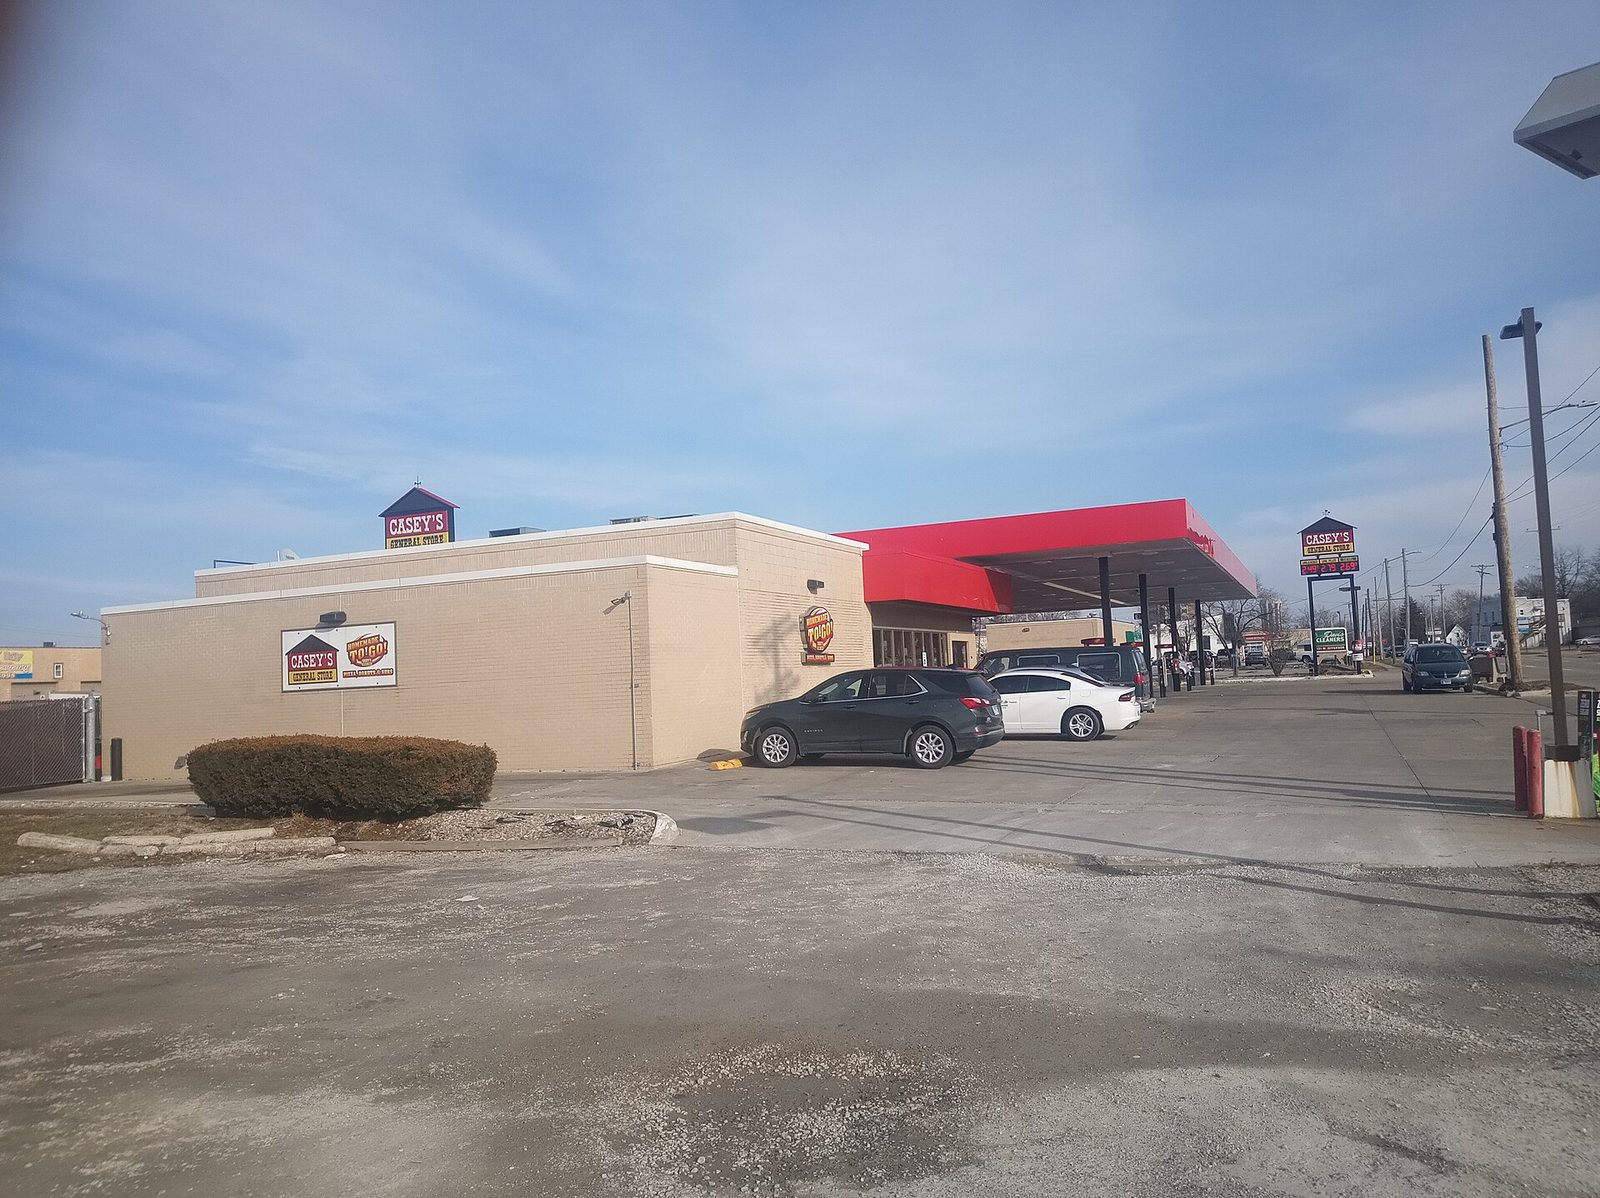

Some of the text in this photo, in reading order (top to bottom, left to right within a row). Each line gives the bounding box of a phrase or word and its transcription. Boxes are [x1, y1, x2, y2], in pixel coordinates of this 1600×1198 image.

[389, 514, 444, 535] CASEY'S
[390, 534, 444, 549] GENERAL STORE
[1306, 532, 1350, 545] CASEY'S
[291, 653, 334, 669] CASEY'S
[293, 671, 333, 682] GENERAL STORE
